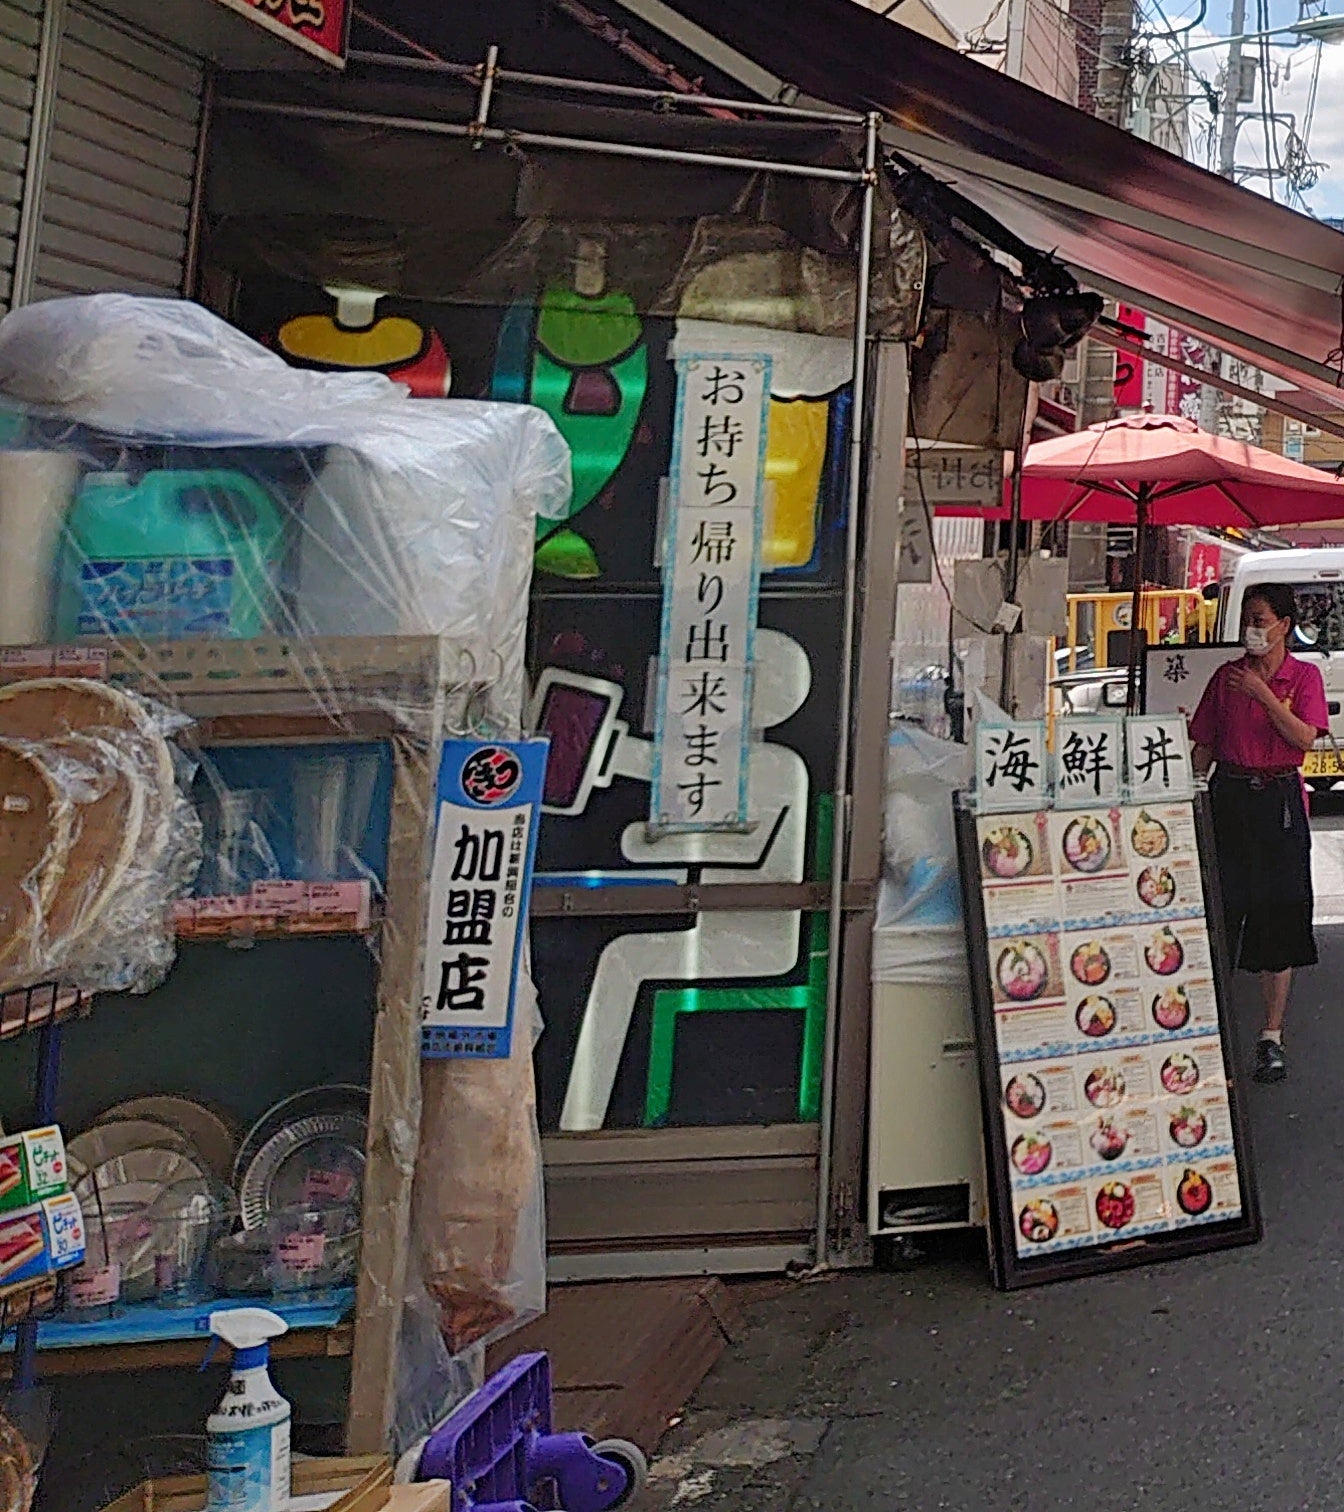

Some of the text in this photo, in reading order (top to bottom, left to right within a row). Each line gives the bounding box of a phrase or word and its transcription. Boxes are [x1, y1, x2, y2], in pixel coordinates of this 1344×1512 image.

[676, 365, 746, 818] お持ち帰り出来ます
[984, 725, 1184, 793] 海鮮丼
[435, 823, 506, 1012] 加盟店
